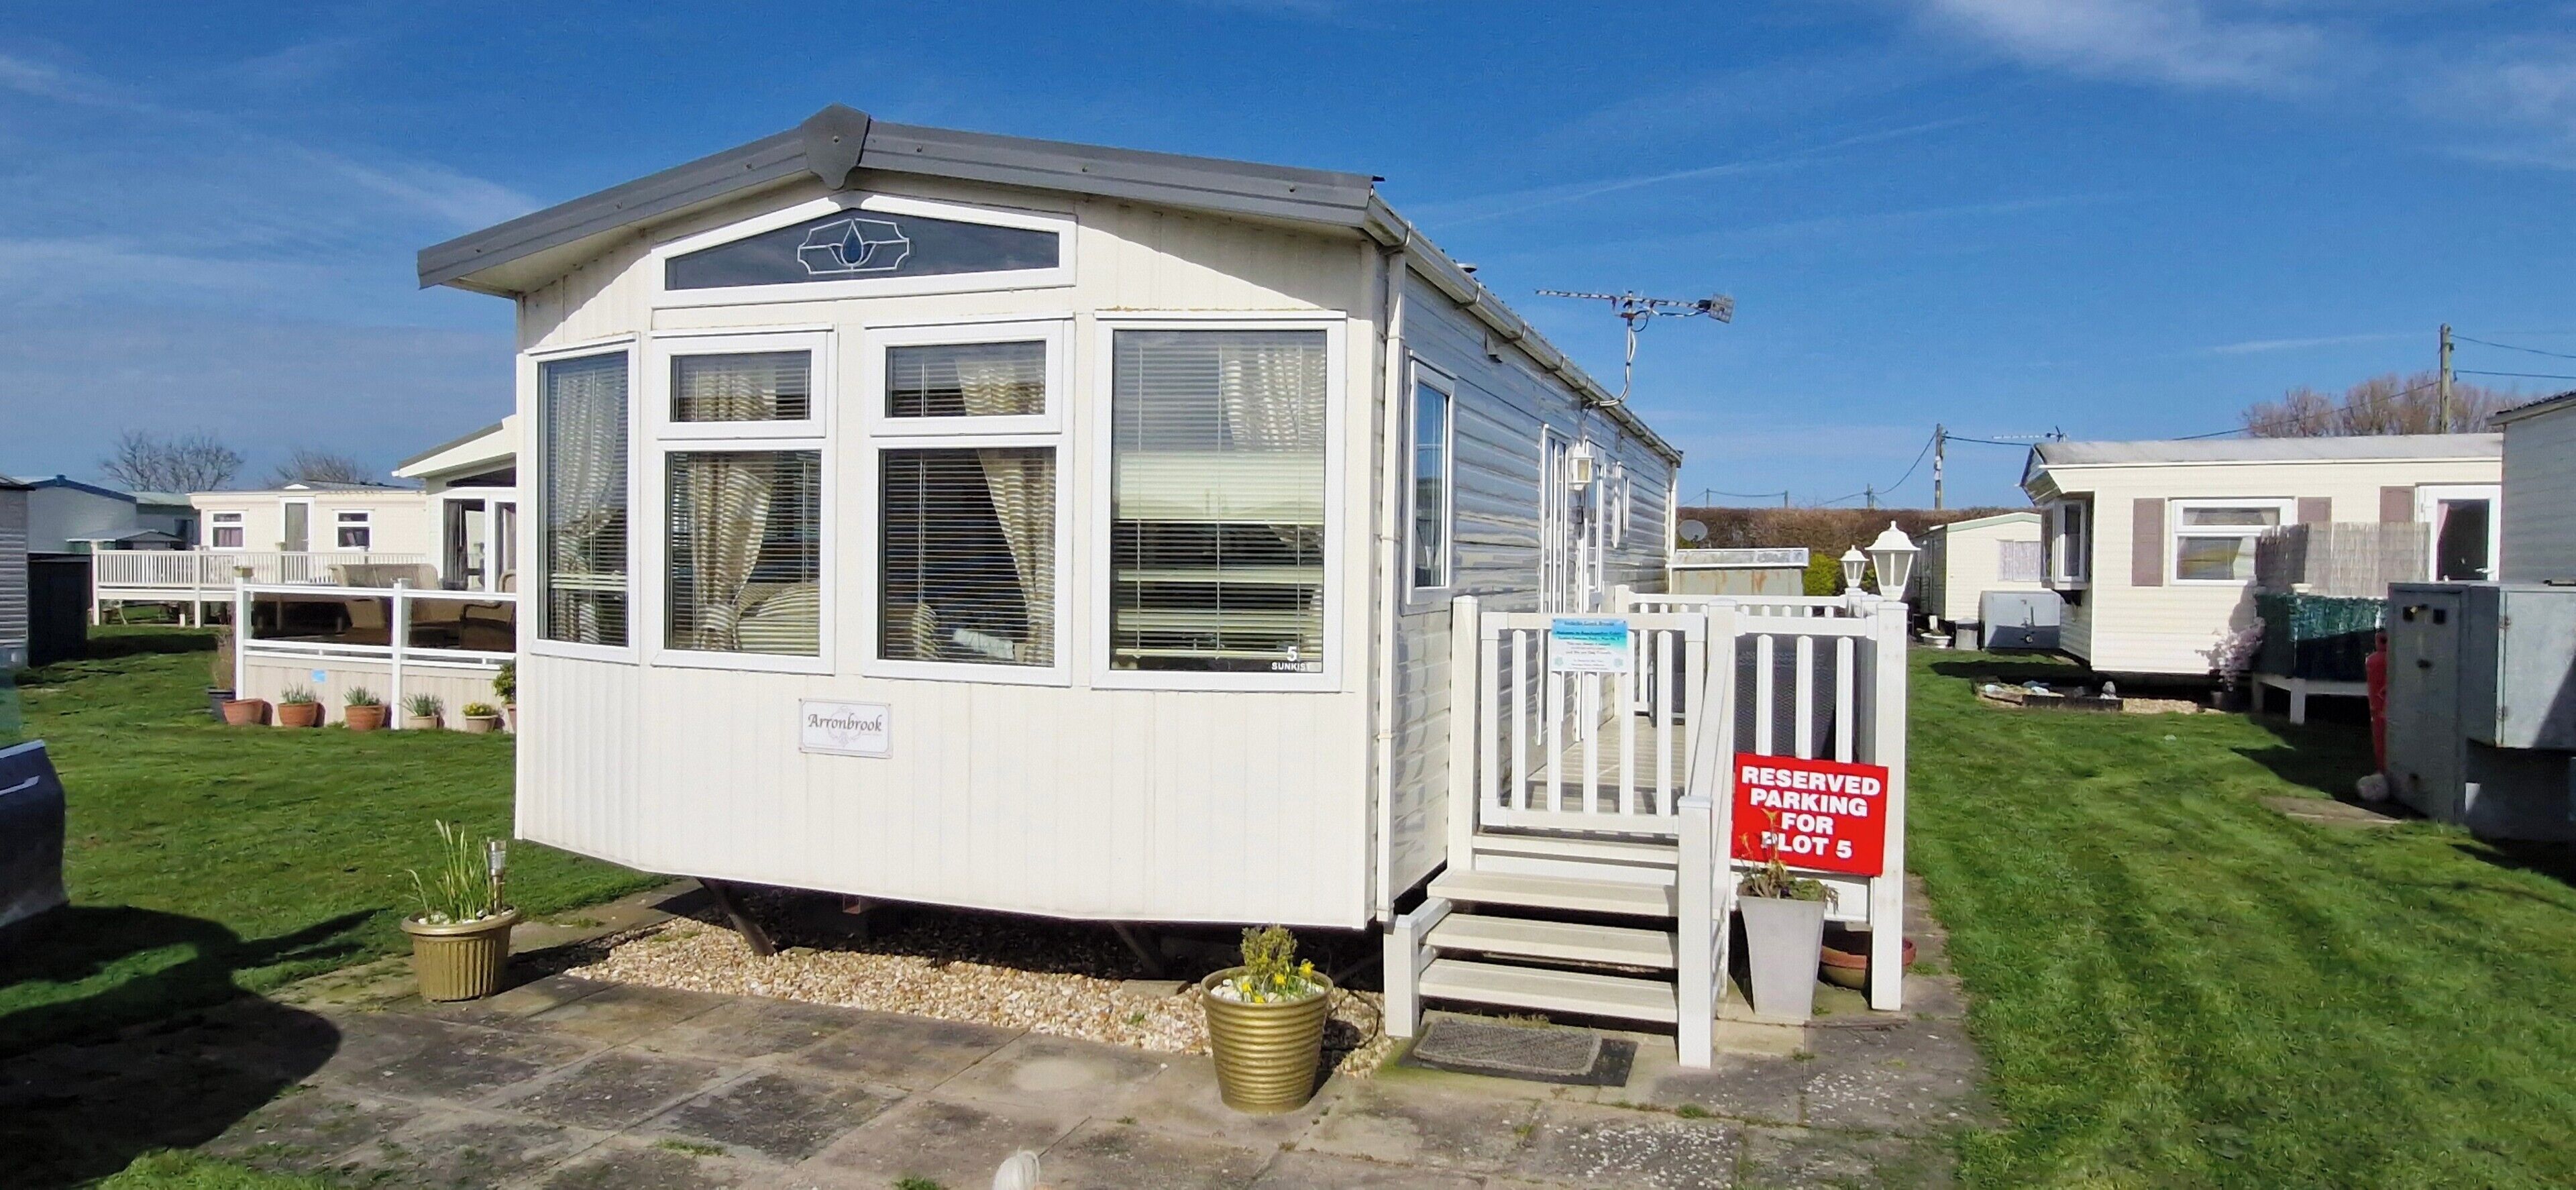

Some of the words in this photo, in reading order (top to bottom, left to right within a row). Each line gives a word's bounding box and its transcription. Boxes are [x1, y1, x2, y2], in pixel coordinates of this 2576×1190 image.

[1287, 645, 1297, 662] 5
[808, 712, 883, 732] Arronbrook
[1741, 765, 1881, 796] RESERVED
[1750, 788, 1868, 817] PARKING
[1781, 812, 1834, 835] FOR
[1761, 830, 1830, 856] PLOT
[1835, 839, 1853, 859] 5
